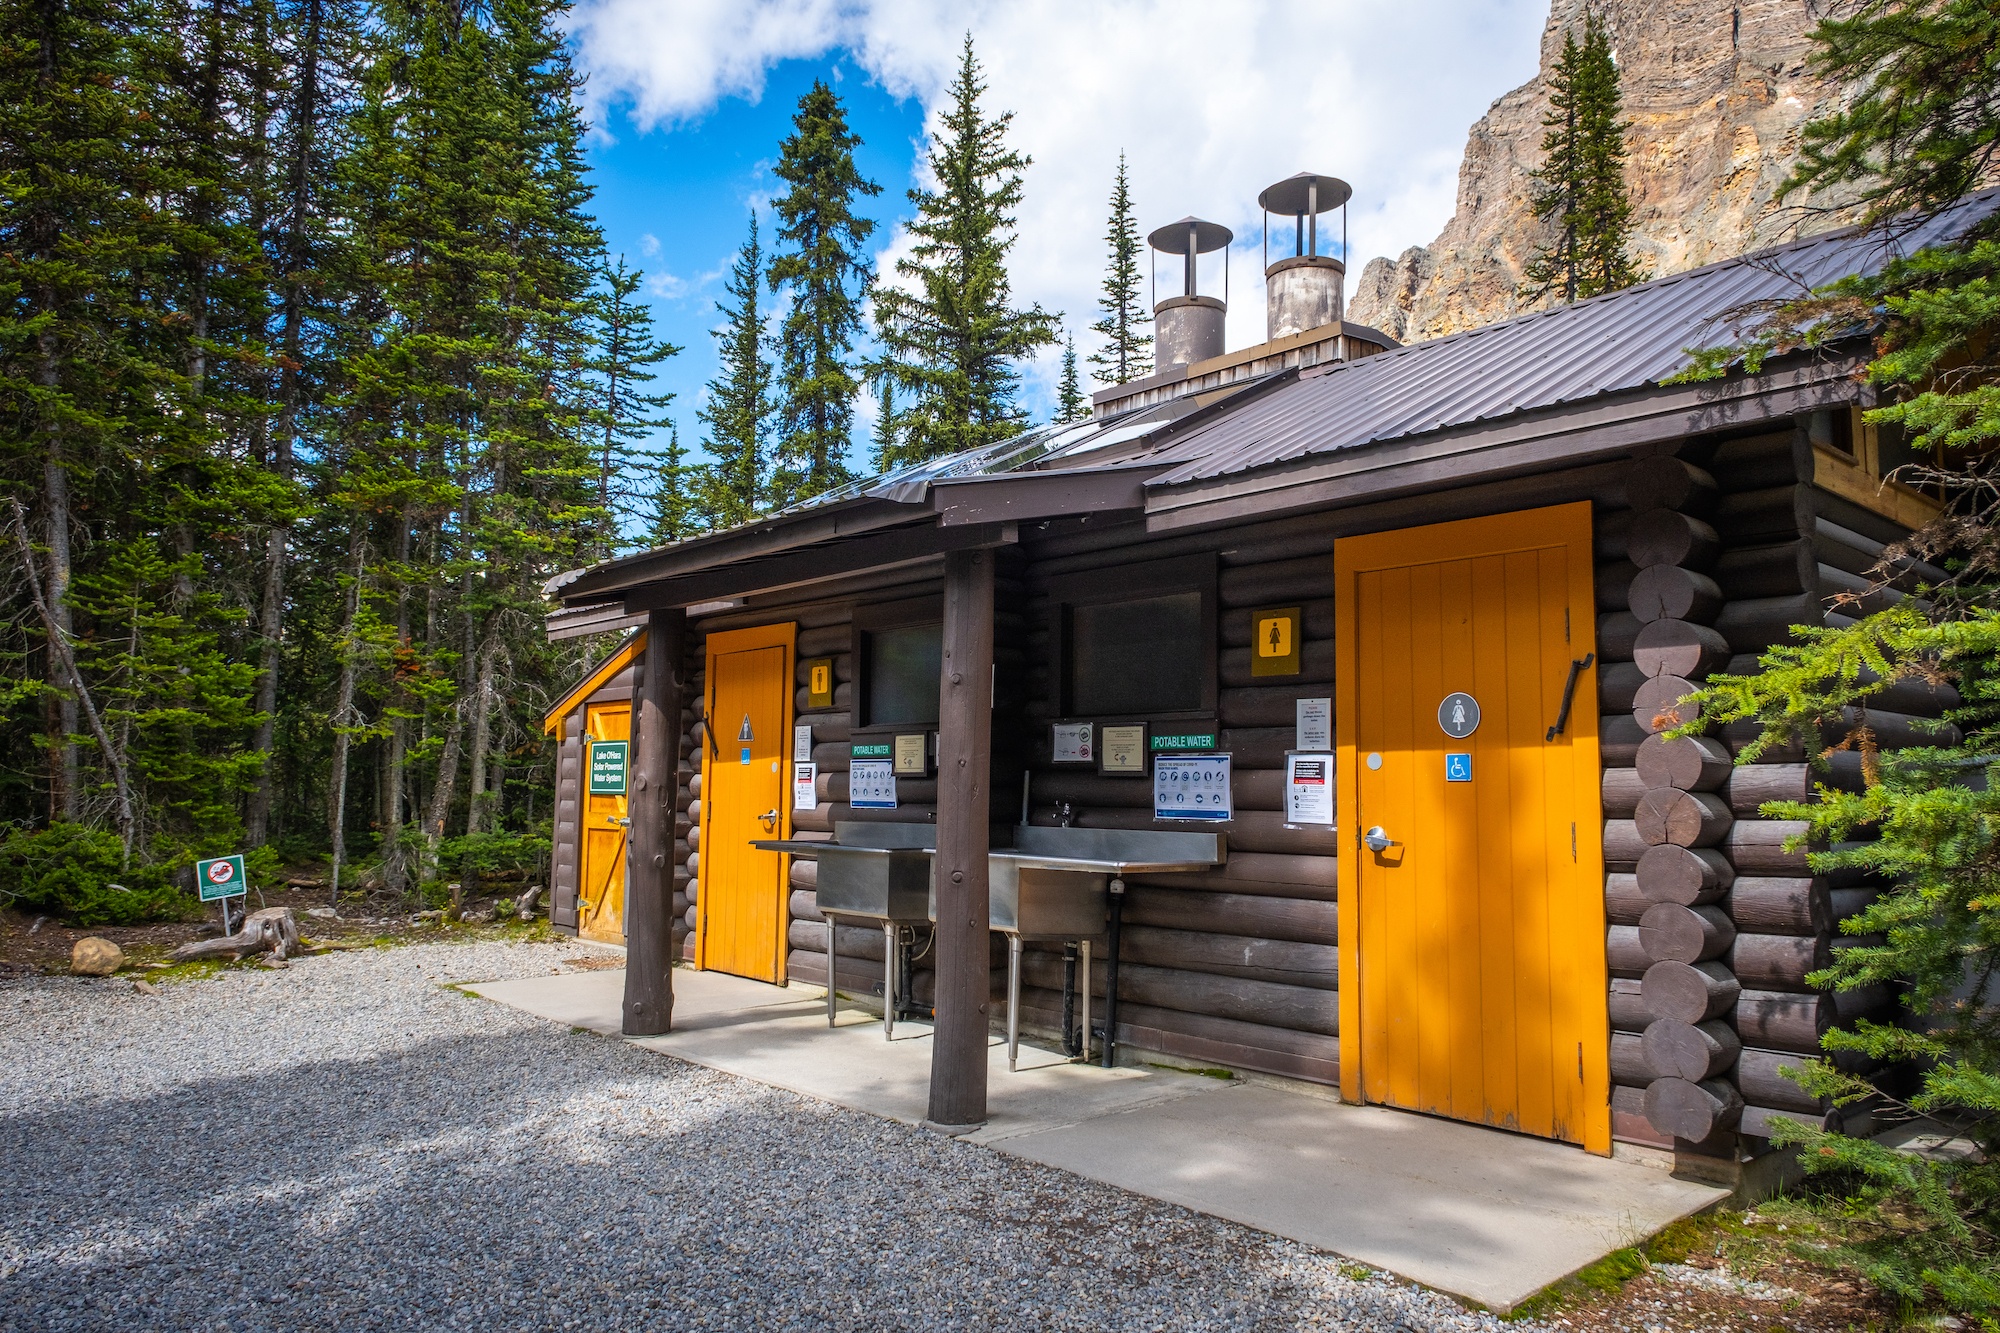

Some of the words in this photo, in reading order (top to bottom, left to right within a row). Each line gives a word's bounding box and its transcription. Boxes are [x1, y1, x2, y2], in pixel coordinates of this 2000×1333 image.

[1154, 736, 1186, 747] POTABLE
[1186, 736, 1211, 747] WATER
[853, 746, 873, 755] POTABLE
[873, 745, 889, 754] WATER
[596, 751, 606, 760] Lake
[606, 751, 621, 759] O'Hara
[593, 762, 604, 771] Solar
[604, 762, 623, 771] Powered
[593, 773, 605, 782] Water
[605, 773, 622, 784] System
